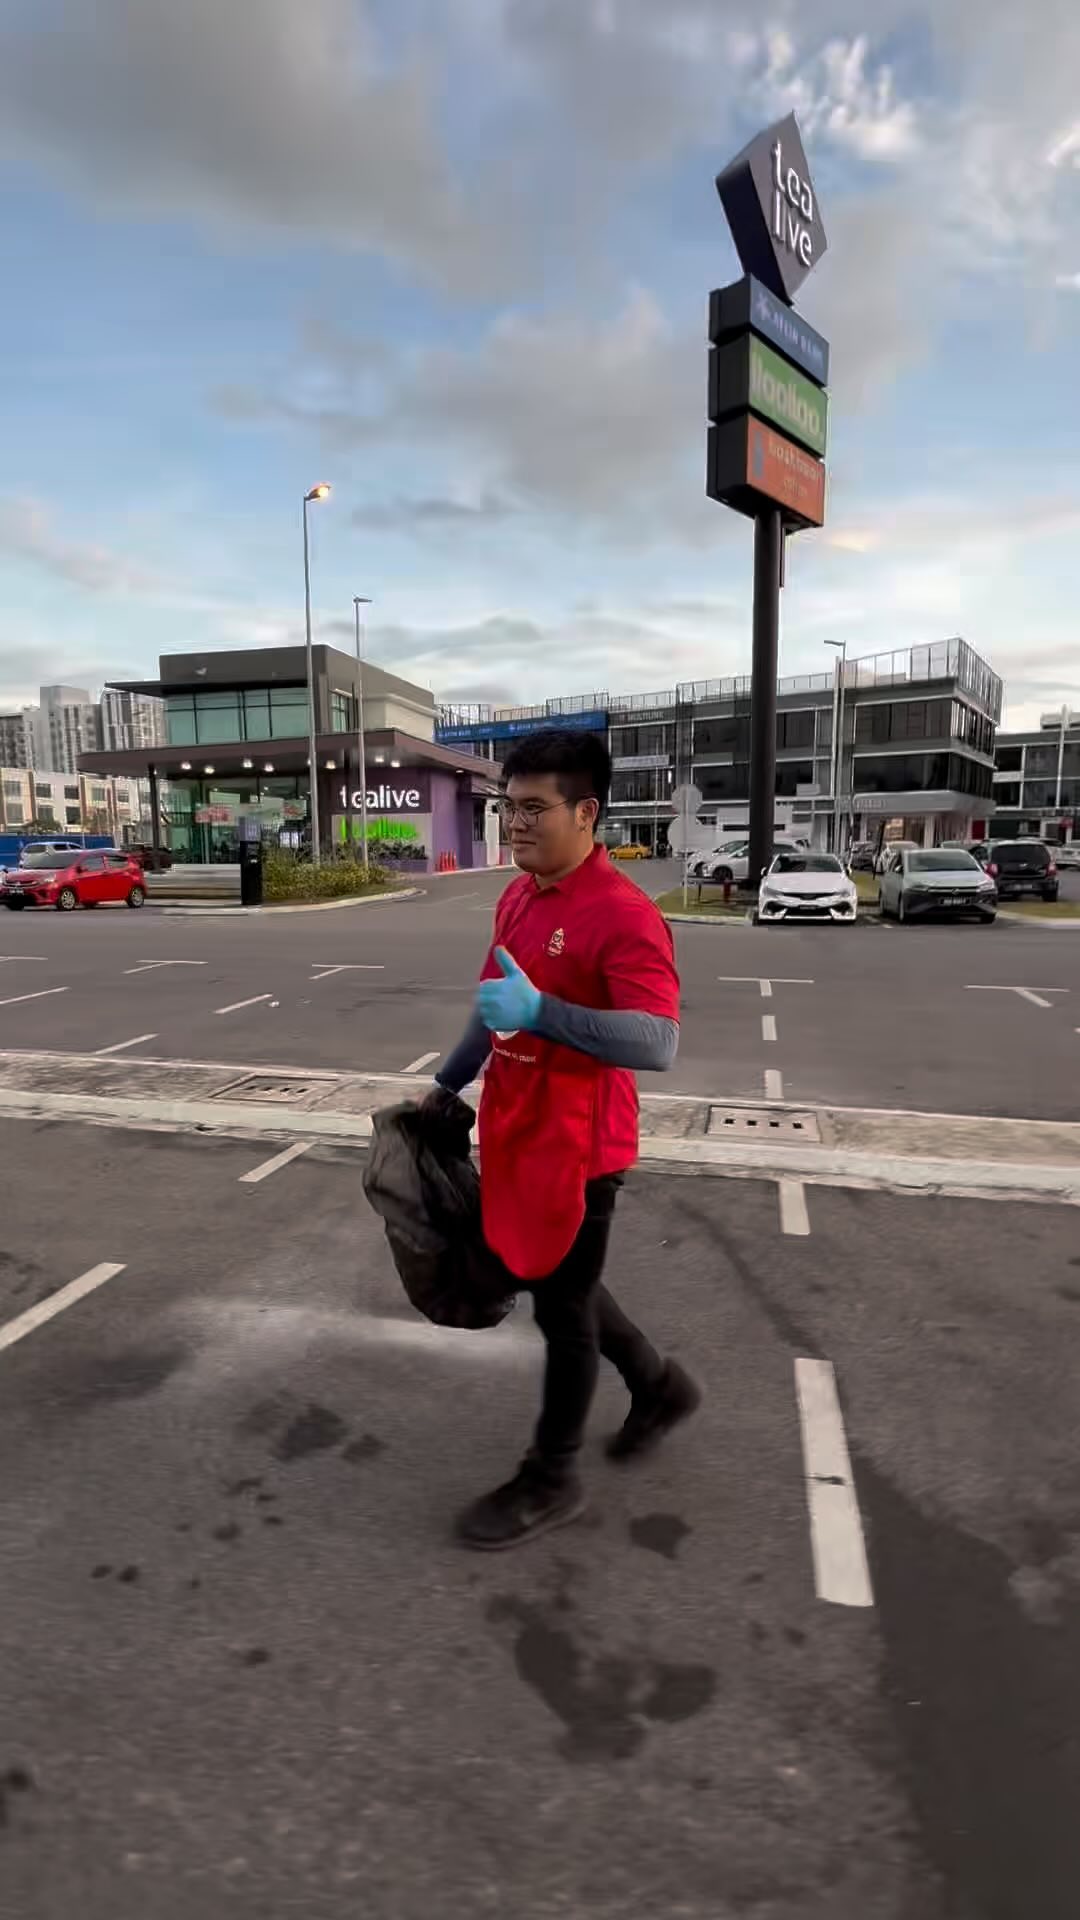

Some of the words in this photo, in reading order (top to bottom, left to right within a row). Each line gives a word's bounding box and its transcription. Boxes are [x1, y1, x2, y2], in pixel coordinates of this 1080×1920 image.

[773, 139, 813, 222] tea
[774, 190, 812, 267] live
[339, 784, 420, 809] tealive
